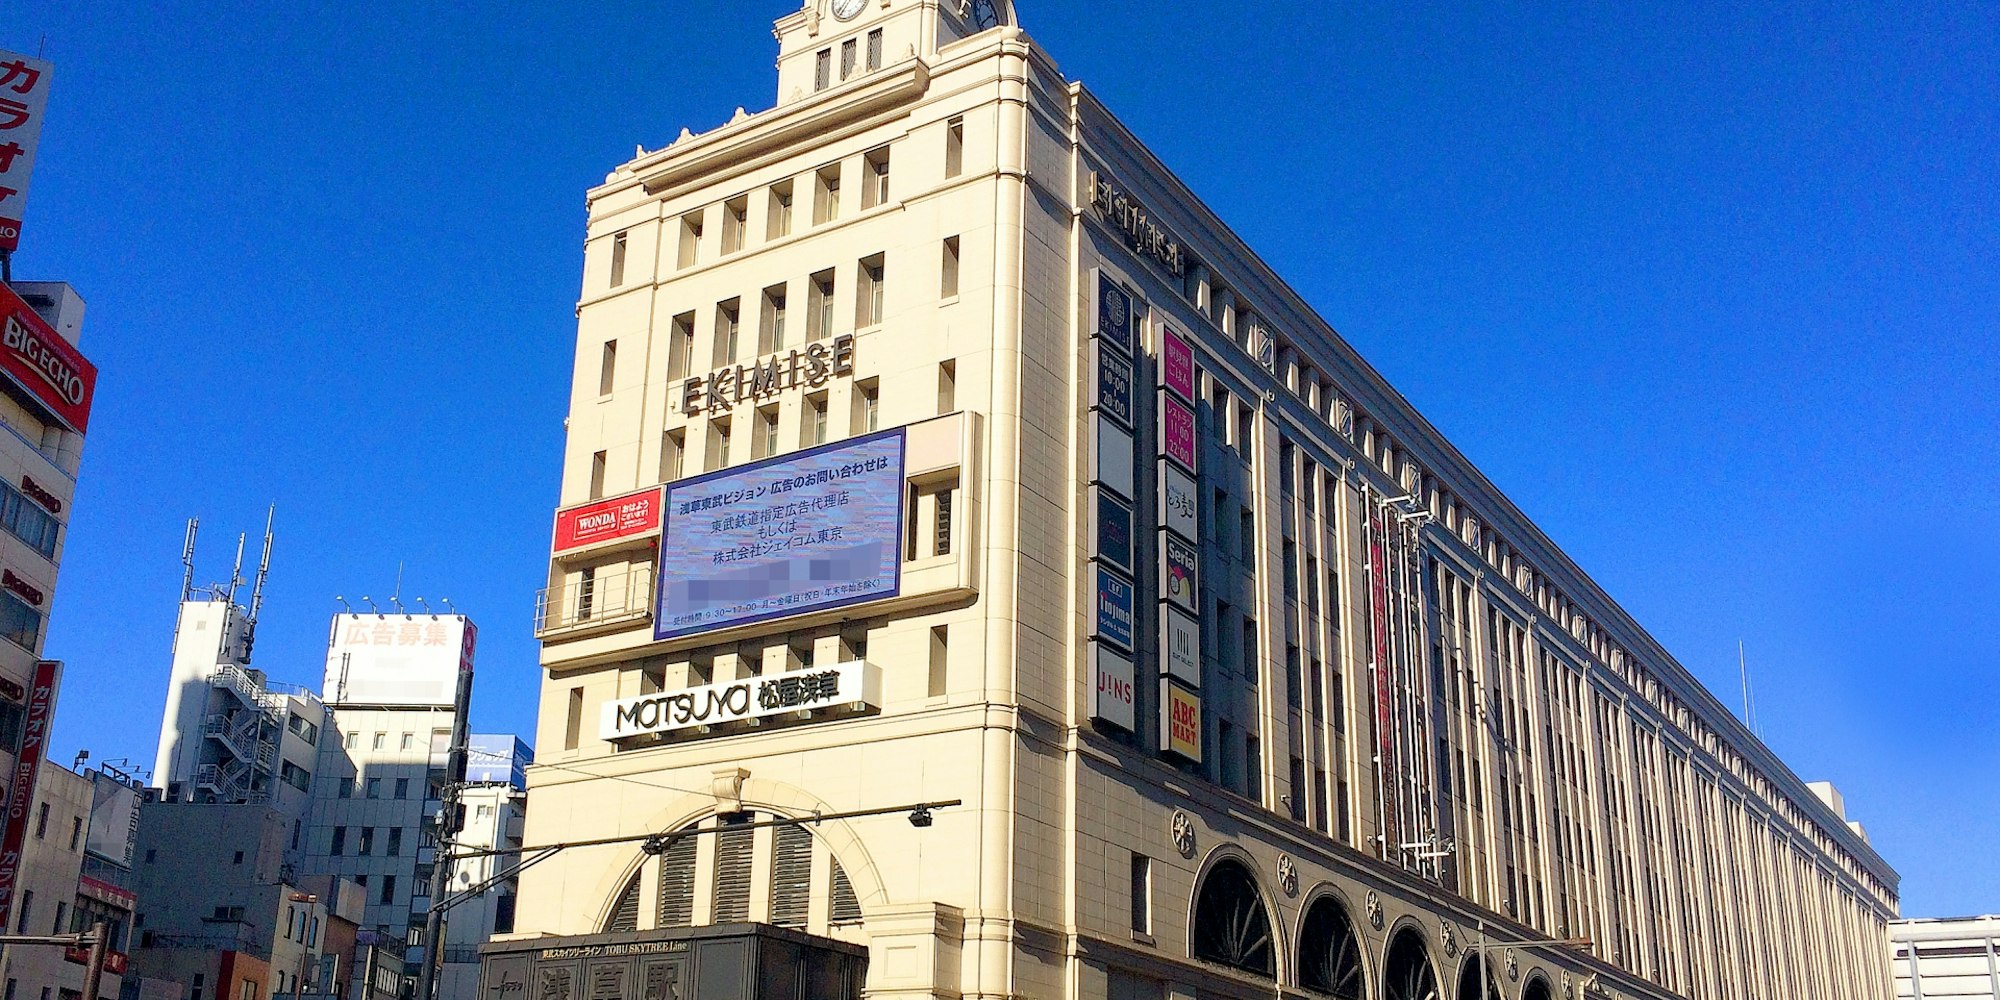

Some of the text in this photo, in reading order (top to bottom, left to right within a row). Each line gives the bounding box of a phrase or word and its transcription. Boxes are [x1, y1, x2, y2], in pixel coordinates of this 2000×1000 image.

[1101, 315, 1130, 347] EKIMISE
[3, 315, 40, 360] BIG
[39, 348, 84, 405] ECHO
[682, 334, 853, 415] EKIMISE
[1104, 369, 1126, 394] 10:00
[1168, 364, 1189, 389] ごはん
[1103, 390, 1126, 416] 20:00
[1167, 403, 1192, 429] レストラン
[1169, 439, 1190, 463] 22:00
[679, 456, 888, 515] 浅草東武ビジョン 広告のお問い合わせは
[622, 499, 649, 514] おはよう
[710, 491, 850, 534] 東武鉄道指定広告代理店
[579, 512, 616, 530] WONDA
[757, 519, 798, 539] もしくは
[713, 526, 843, 566] 株式会社ジェイコム東京
[1168, 542, 1195, 571] Seria
[344, 622, 448, 647] 広告募集
[758, 670, 840, 710] 松屋浅草
[25, 685, 50, 748] カラオケ
[1172, 698, 1196, 729] ABC
[1172, 722, 1197, 746] MART
[20, 762, 32, 785] BIG
[10, 786, 27, 818] ECHO
[542, 941, 688, 959] 東武スカイツリーライン TOBU SKYTREE Line
[541, 963, 679, 1000] 浅草駅
